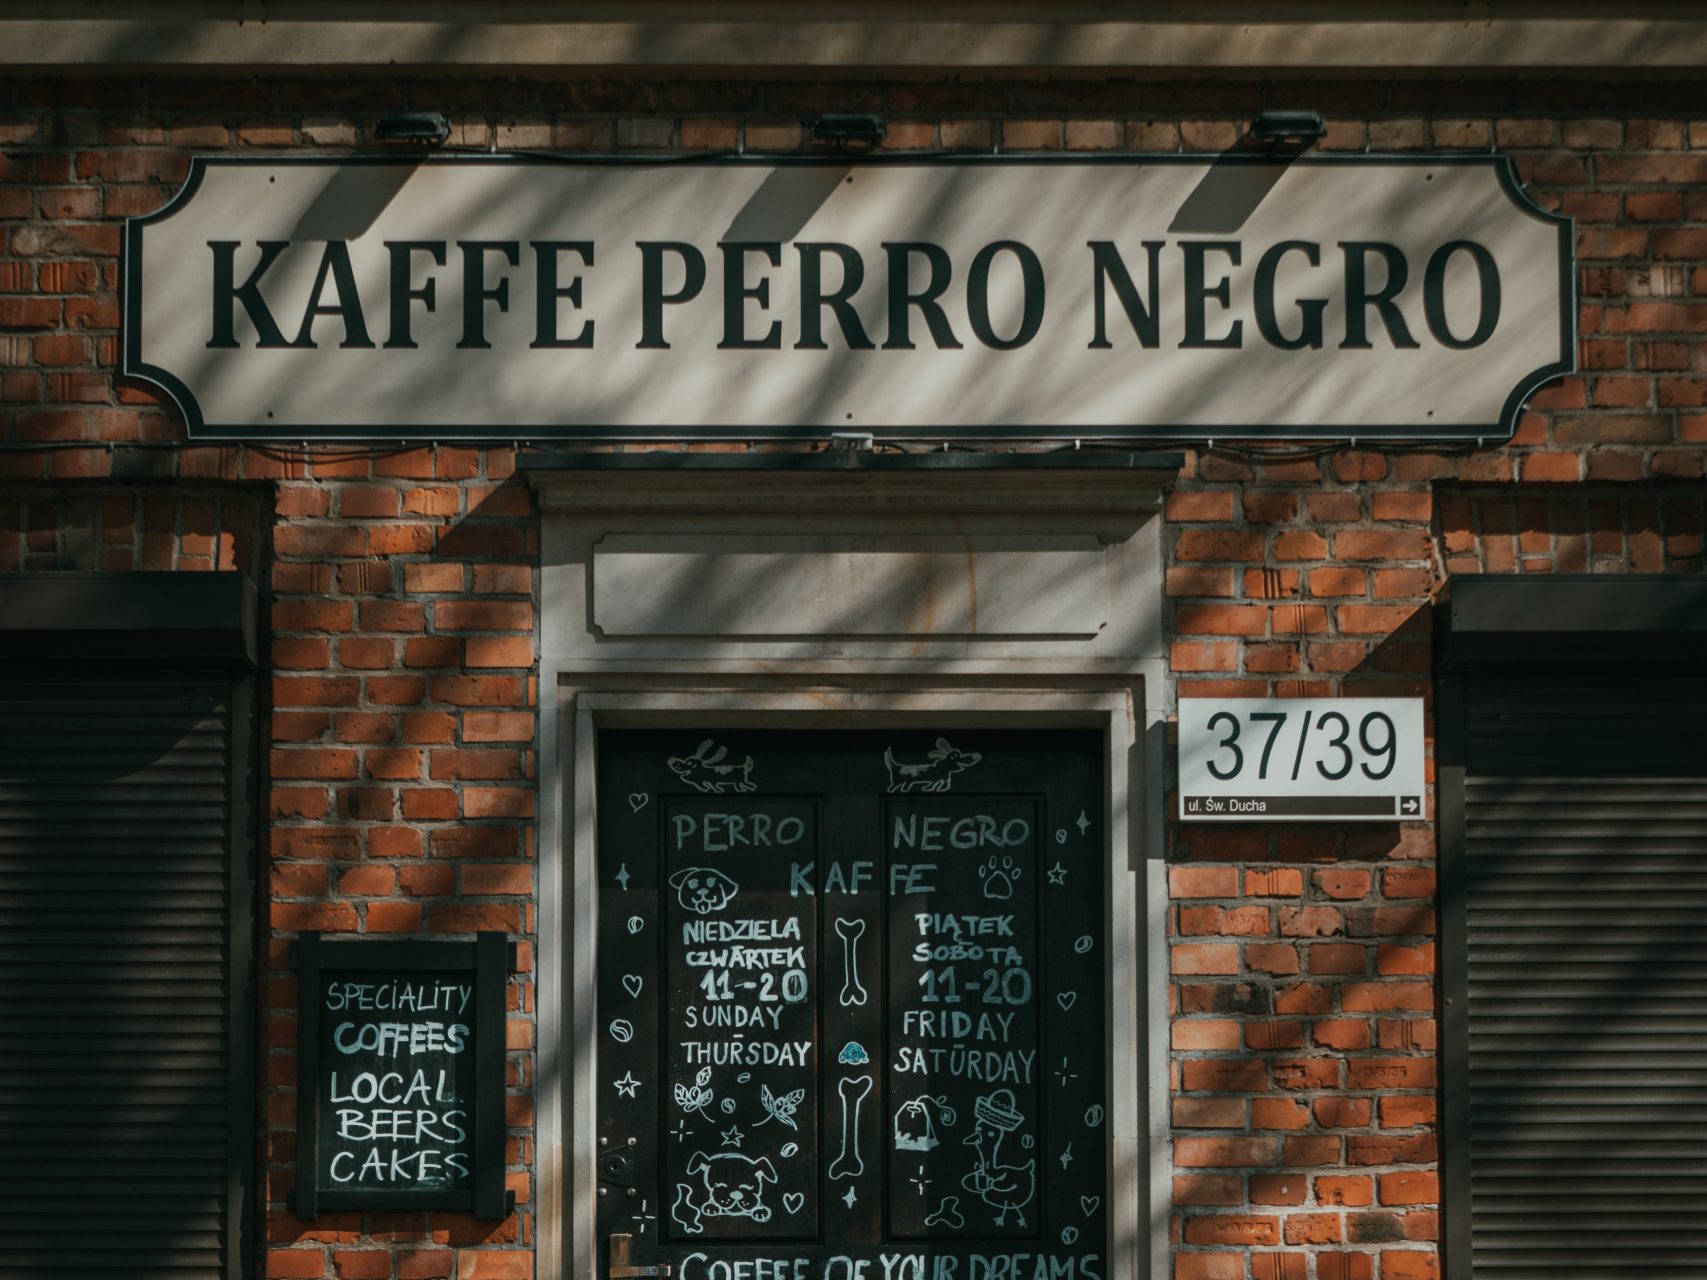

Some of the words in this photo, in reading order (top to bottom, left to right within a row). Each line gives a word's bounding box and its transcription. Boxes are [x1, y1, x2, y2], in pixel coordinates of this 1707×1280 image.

[205, 240, 595, 350] KAFFE
[635, 240, 1046, 351] PERRO
[1087, 240, 1501, 351] NEGRO
[1207, 711, 1396, 780] 37/39
[1189, 799, 1201, 811] ul.
[1204, 796, 1228, 811] Św.
[1230, 799, 1266, 811] Ducha
[672, 813, 804, 851] PERRO
[894, 814, 1029, 850] NEGRO
[682, 916, 801, 945] NIEDZIELA
[914, 912, 1014, 942] PIĄTEK
[685, 946, 807, 970] CZWARTEK
[912, 942, 1023, 966] SOBOTA
[700, 968, 808, 1001] 11-20
[918, 966, 1032, 1005] 11-20
[685, 1005, 783, 1029] SUNDAY
[903, 1010, 1015, 1043] FRIDAY
[334, 1021, 470, 1058] COFFEES
[681, 1041, 812, 1066] THURSDAY
[893, 1047, 1036, 1084] SATURDAY
[331, 1069, 457, 1105] LOCAL
[336, 1109, 467, 1144] BEERS
[330, 1147, 469, 1182] CAKES
